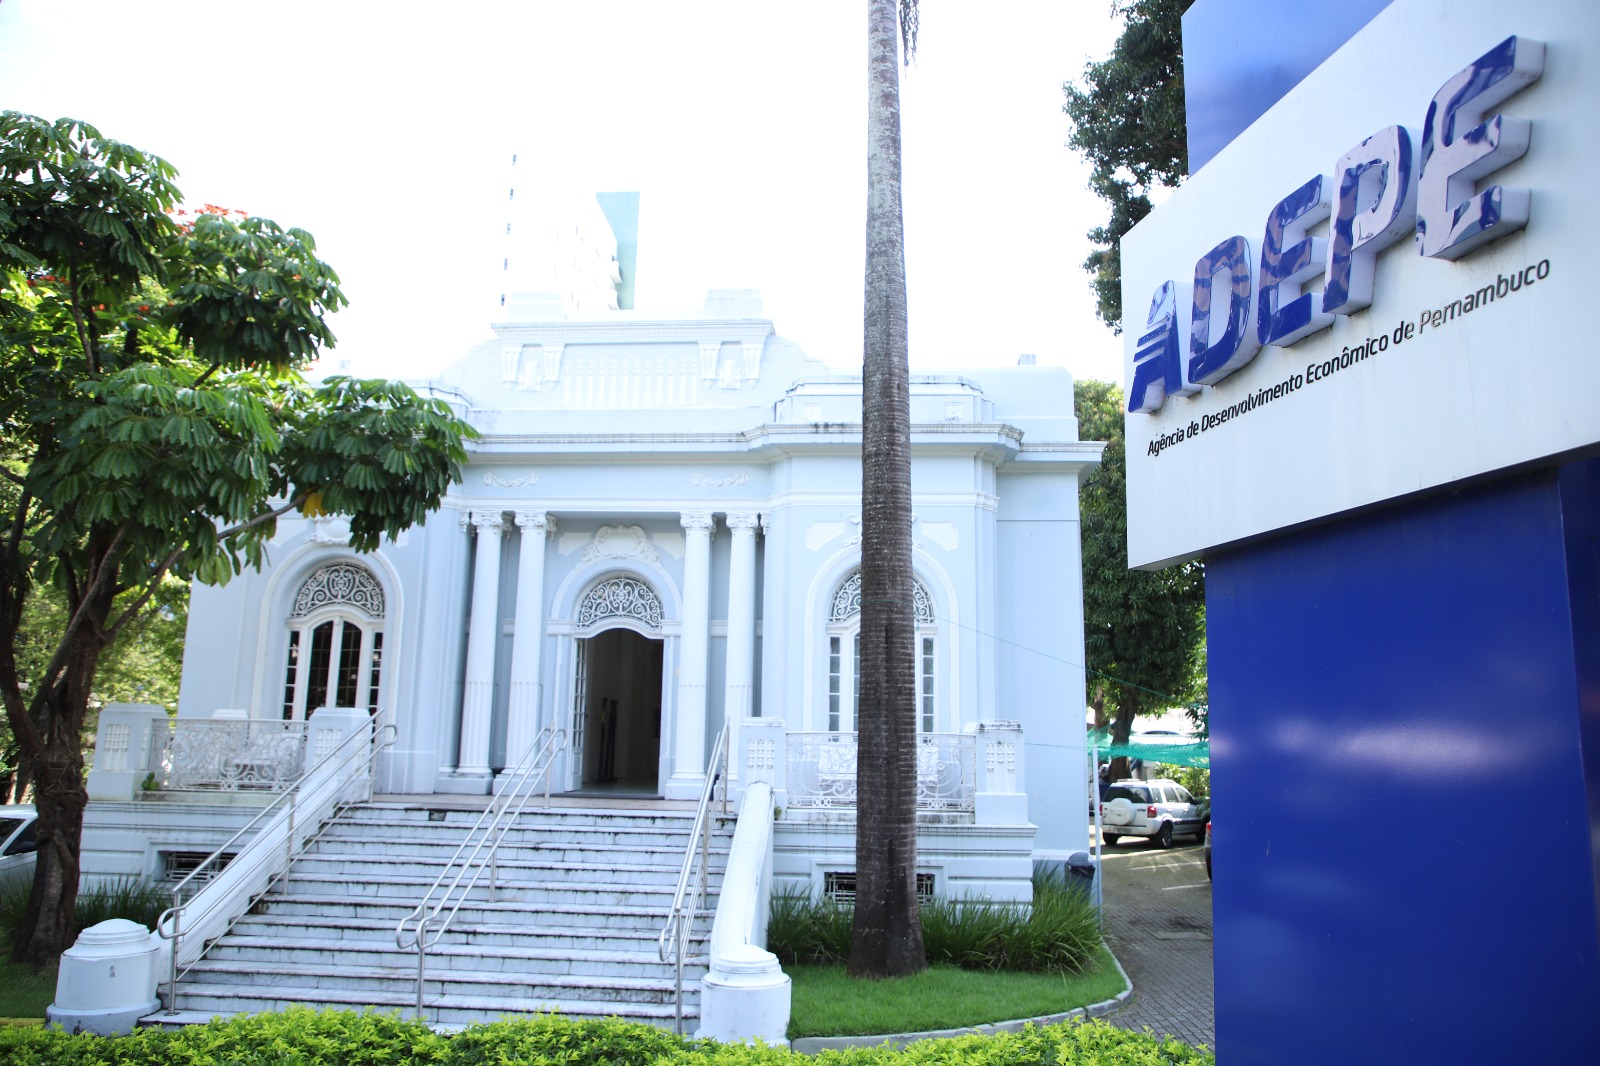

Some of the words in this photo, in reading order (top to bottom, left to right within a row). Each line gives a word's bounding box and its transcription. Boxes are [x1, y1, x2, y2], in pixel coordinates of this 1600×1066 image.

[1128, 34, 1546, 414] ADEPE
[1148, 428, 1185, 457] Agência
[1187, 421, 1199, 439] de
[1201, 374, 1303, 432] Desenvolvimento
[1306, 334, 1389, 384] Econômico
[1393, 321, 1414, 345] de
[1419, 259, 1550, 334] Pernambuco
